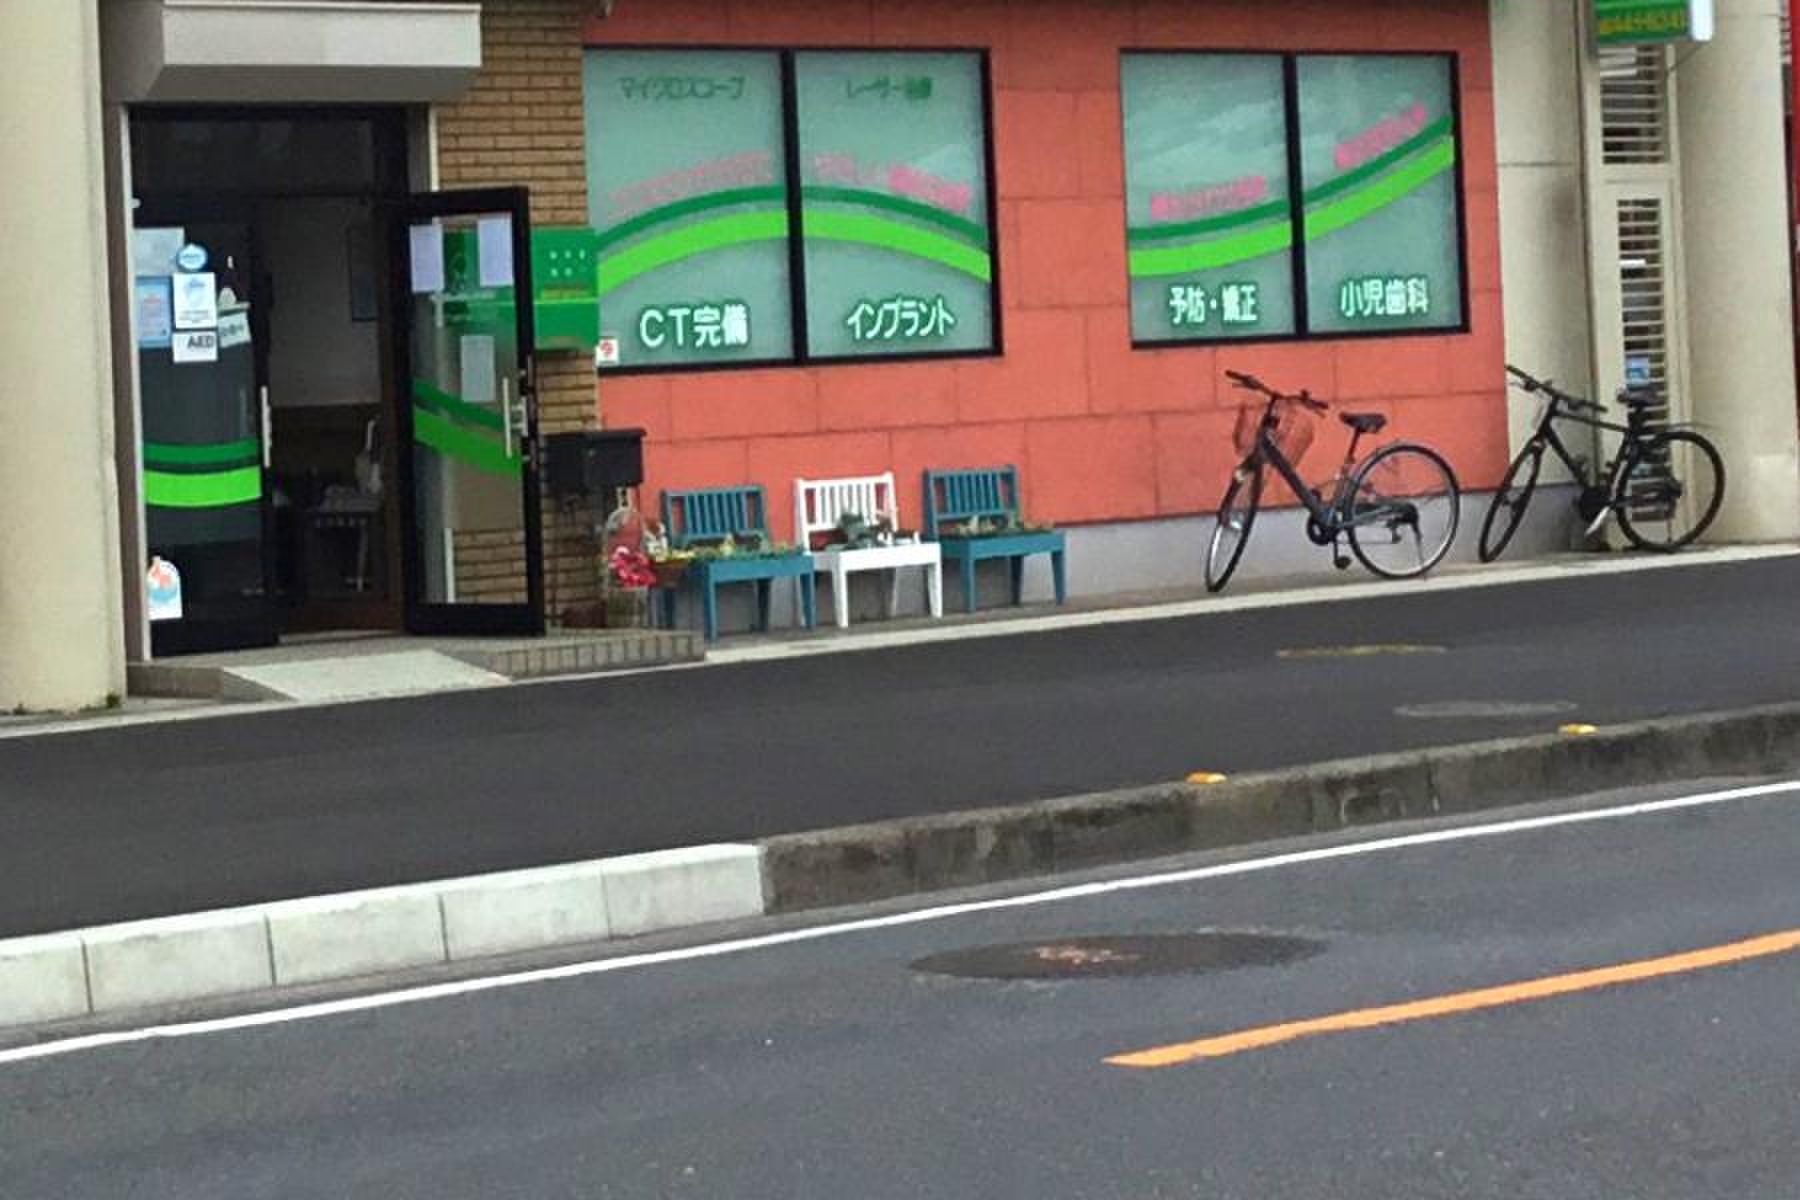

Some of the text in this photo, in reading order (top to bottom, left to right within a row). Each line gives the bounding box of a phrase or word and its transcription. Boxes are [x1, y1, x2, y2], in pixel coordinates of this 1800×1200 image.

[1341, 278, 1429, 316] 小児歯科
[640, 304, 749, 348] CT完備
[847, 299, 954, 340] インプラント
